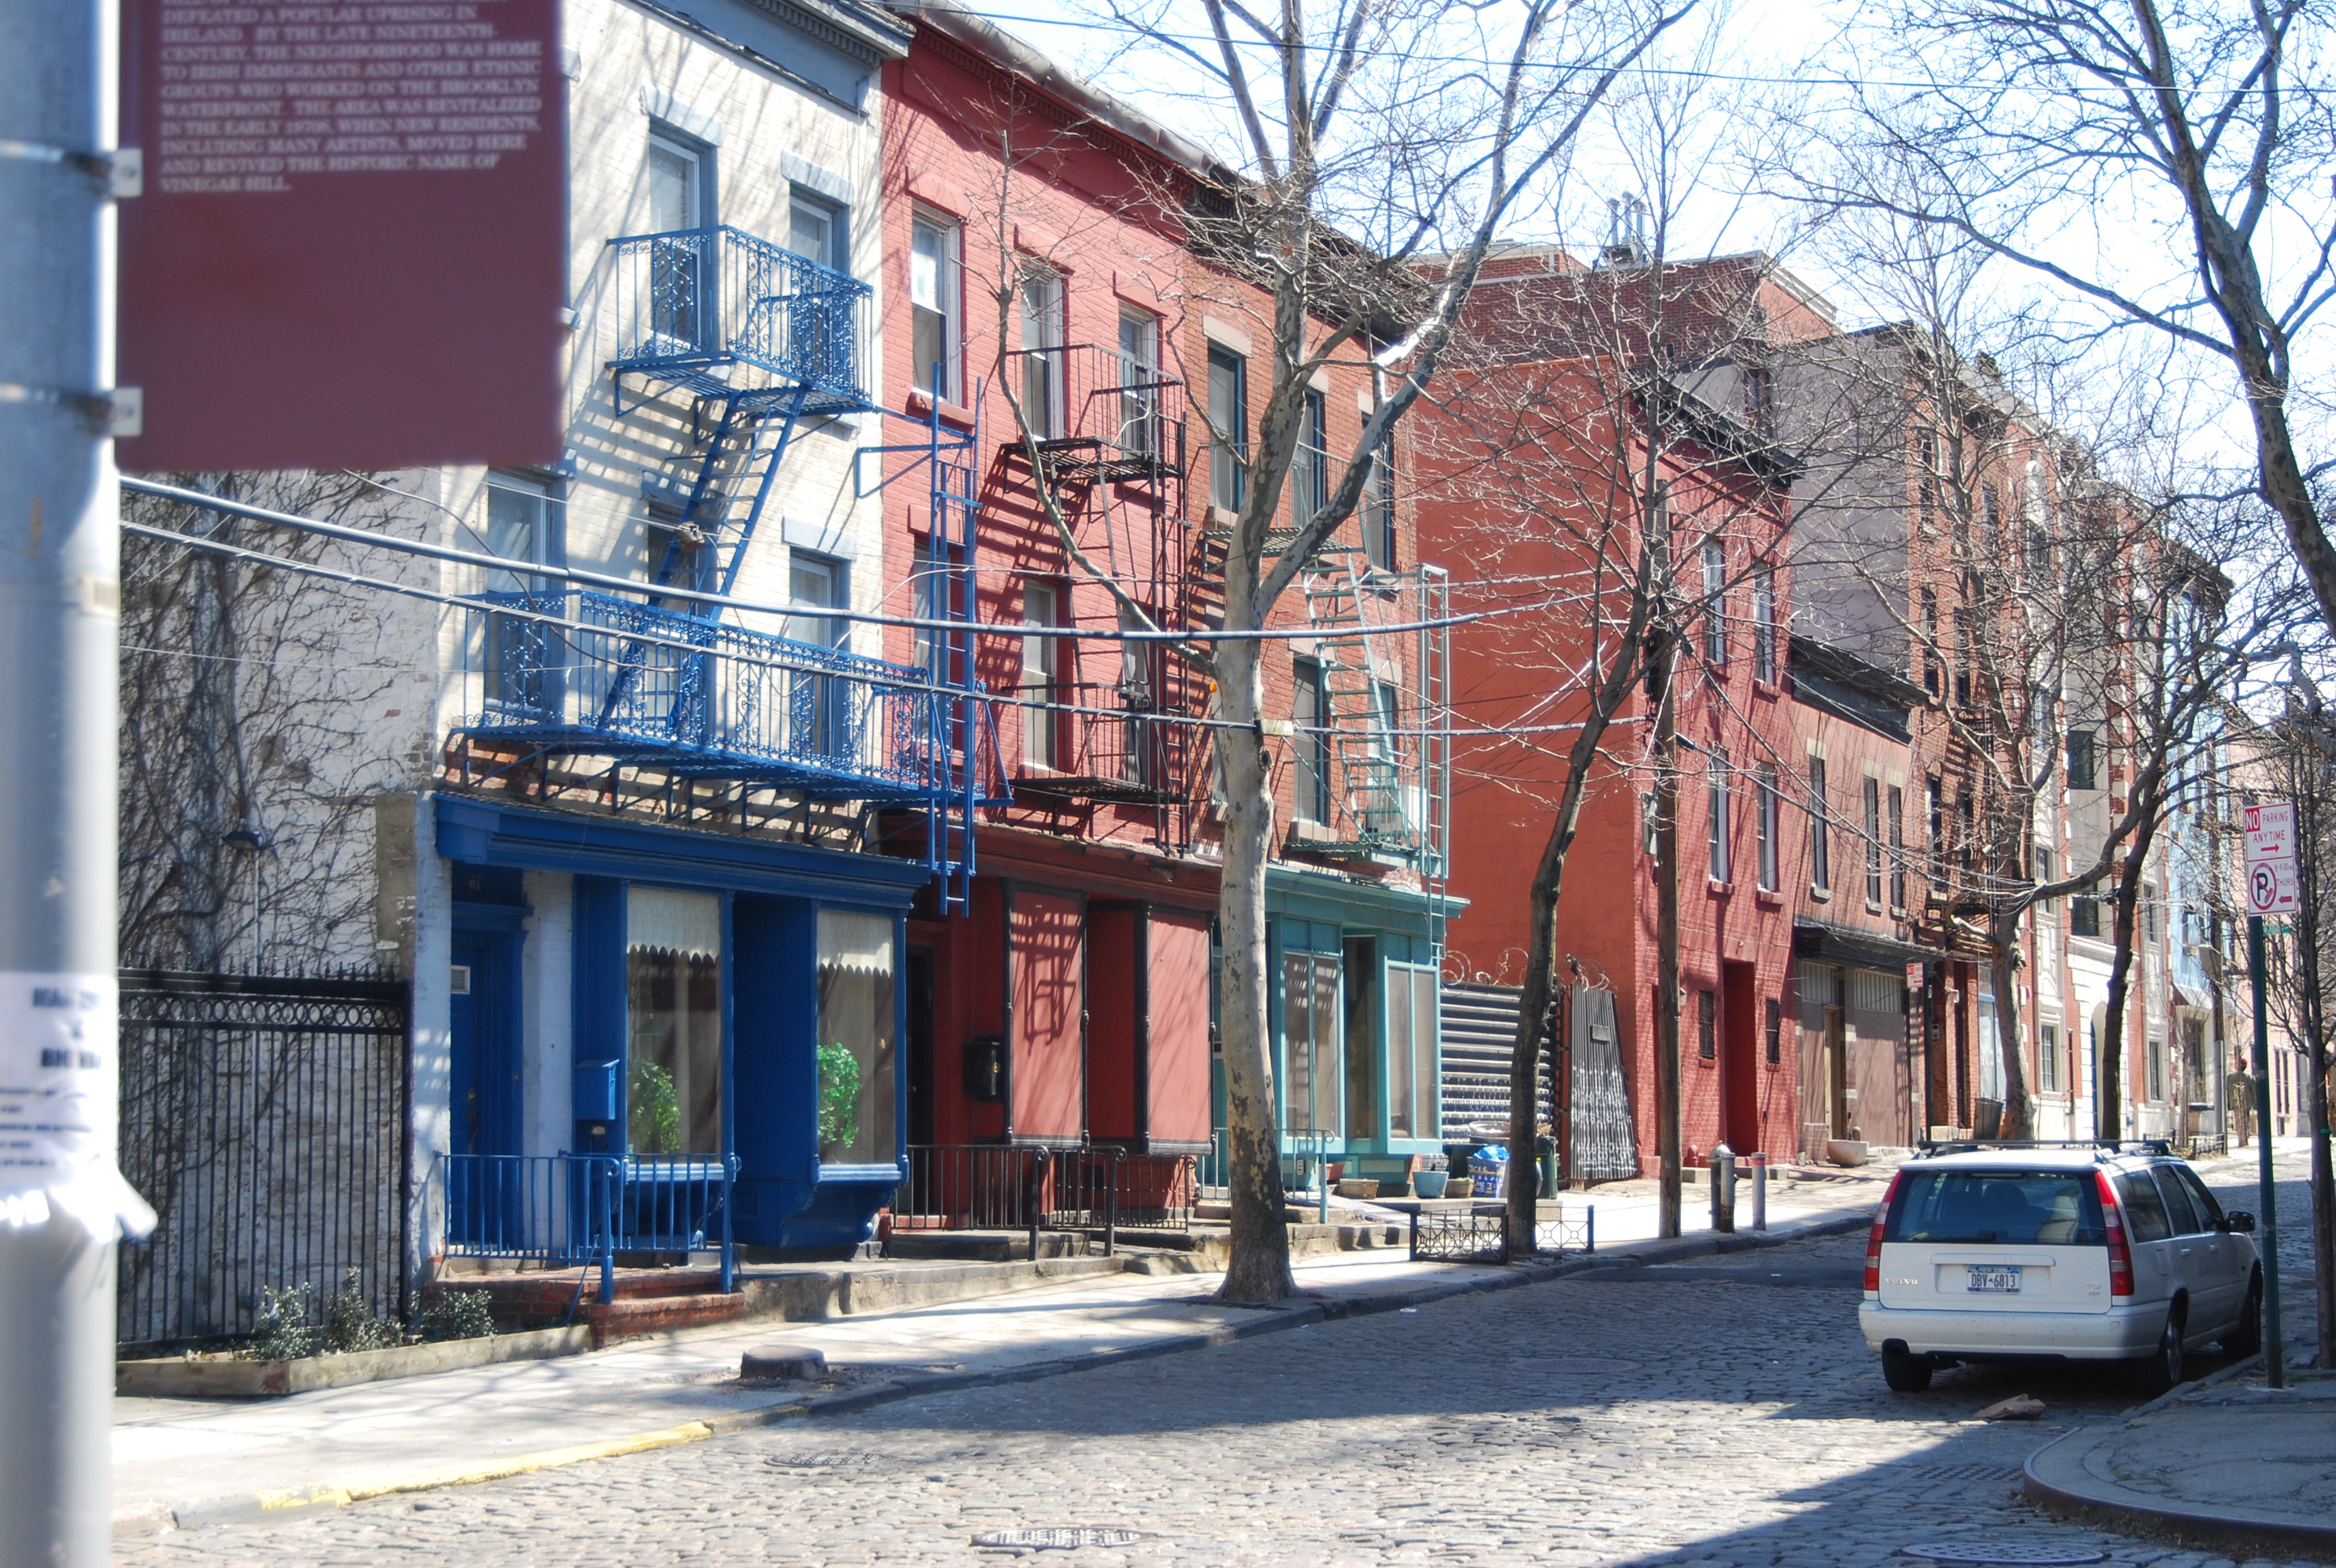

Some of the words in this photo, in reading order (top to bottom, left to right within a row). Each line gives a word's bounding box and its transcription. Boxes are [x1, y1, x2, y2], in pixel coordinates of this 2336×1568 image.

[262, 10, 276, 23] A
[280, 7, 361, 22] POPULAR
[367, 6, 452, 21] UPRISING
[457, 6, 477, 19] IN
[255, 27, 278, 41] BY
[284, 26, 321, 41] THE
[325, 25, 370, 40] LATE
[252, 44, 292, 60] THE
[294, 44, 440, 58] NEIGHBORHOOD
[444, 42, 483, 56] WAS
[486, 41, 541, 56] HOME
[161, 65, 186, 80] TO
[190, 65, 240, 80] IRISH
[244, 63, 361, 78] IMMIGRANTS
[364, 62, 402, 77] AND
[406, 60, 468, 76] OTHER
[473, 60, 541, 75] ETHNIC
[162, 83, 235, 98] GROUPS
[239, 82, 282, 97] WHO
[286, 81, 365, 96] WORKED
[367, 81, 395, 95] ON
[399, 80, 436, 95] THE
[440, 79, 539, 94] BROOKLYN
[294, 100, 332, 115] THE
[335, 100, 382, 115] AREA
[386, 99, 423, 114] WAS
[427, 97, 541, 113] REVITALIZED
[160, 121, 182, 136] IN
[186, 120, 223, 136] THE
[225, 119, 282, 136] EARLY
[337, 118, 392, 133] WHEN
[395, 117, 436, 132] NEW
[160, 139, 265, 154] INCLUDING
[267, 138, 321, 153] MANY
[407, 136, 472, 151] MOVED
[475, 134, 528, 150] HERE
[160, 158, 200, 173] AND
[203, 157, 283, 173] REVIVED
[288, 156, 325, 172] THE
[328, 155, 415, 170] HISTORIC
[417, 154, 471, 169] NAME
[474, 153, 501, 168] OF
[160, 177, 240, 192] VINEGAR
[2246, 811, 2259, 830] NO
[2263, 811, 2288, 824] PARKING
[2253, 830, 2285, 844] ANYTIME
[2276, 877, 2294, 887] THURS
[1885, 1278, 1918, 1286] VOLVO
